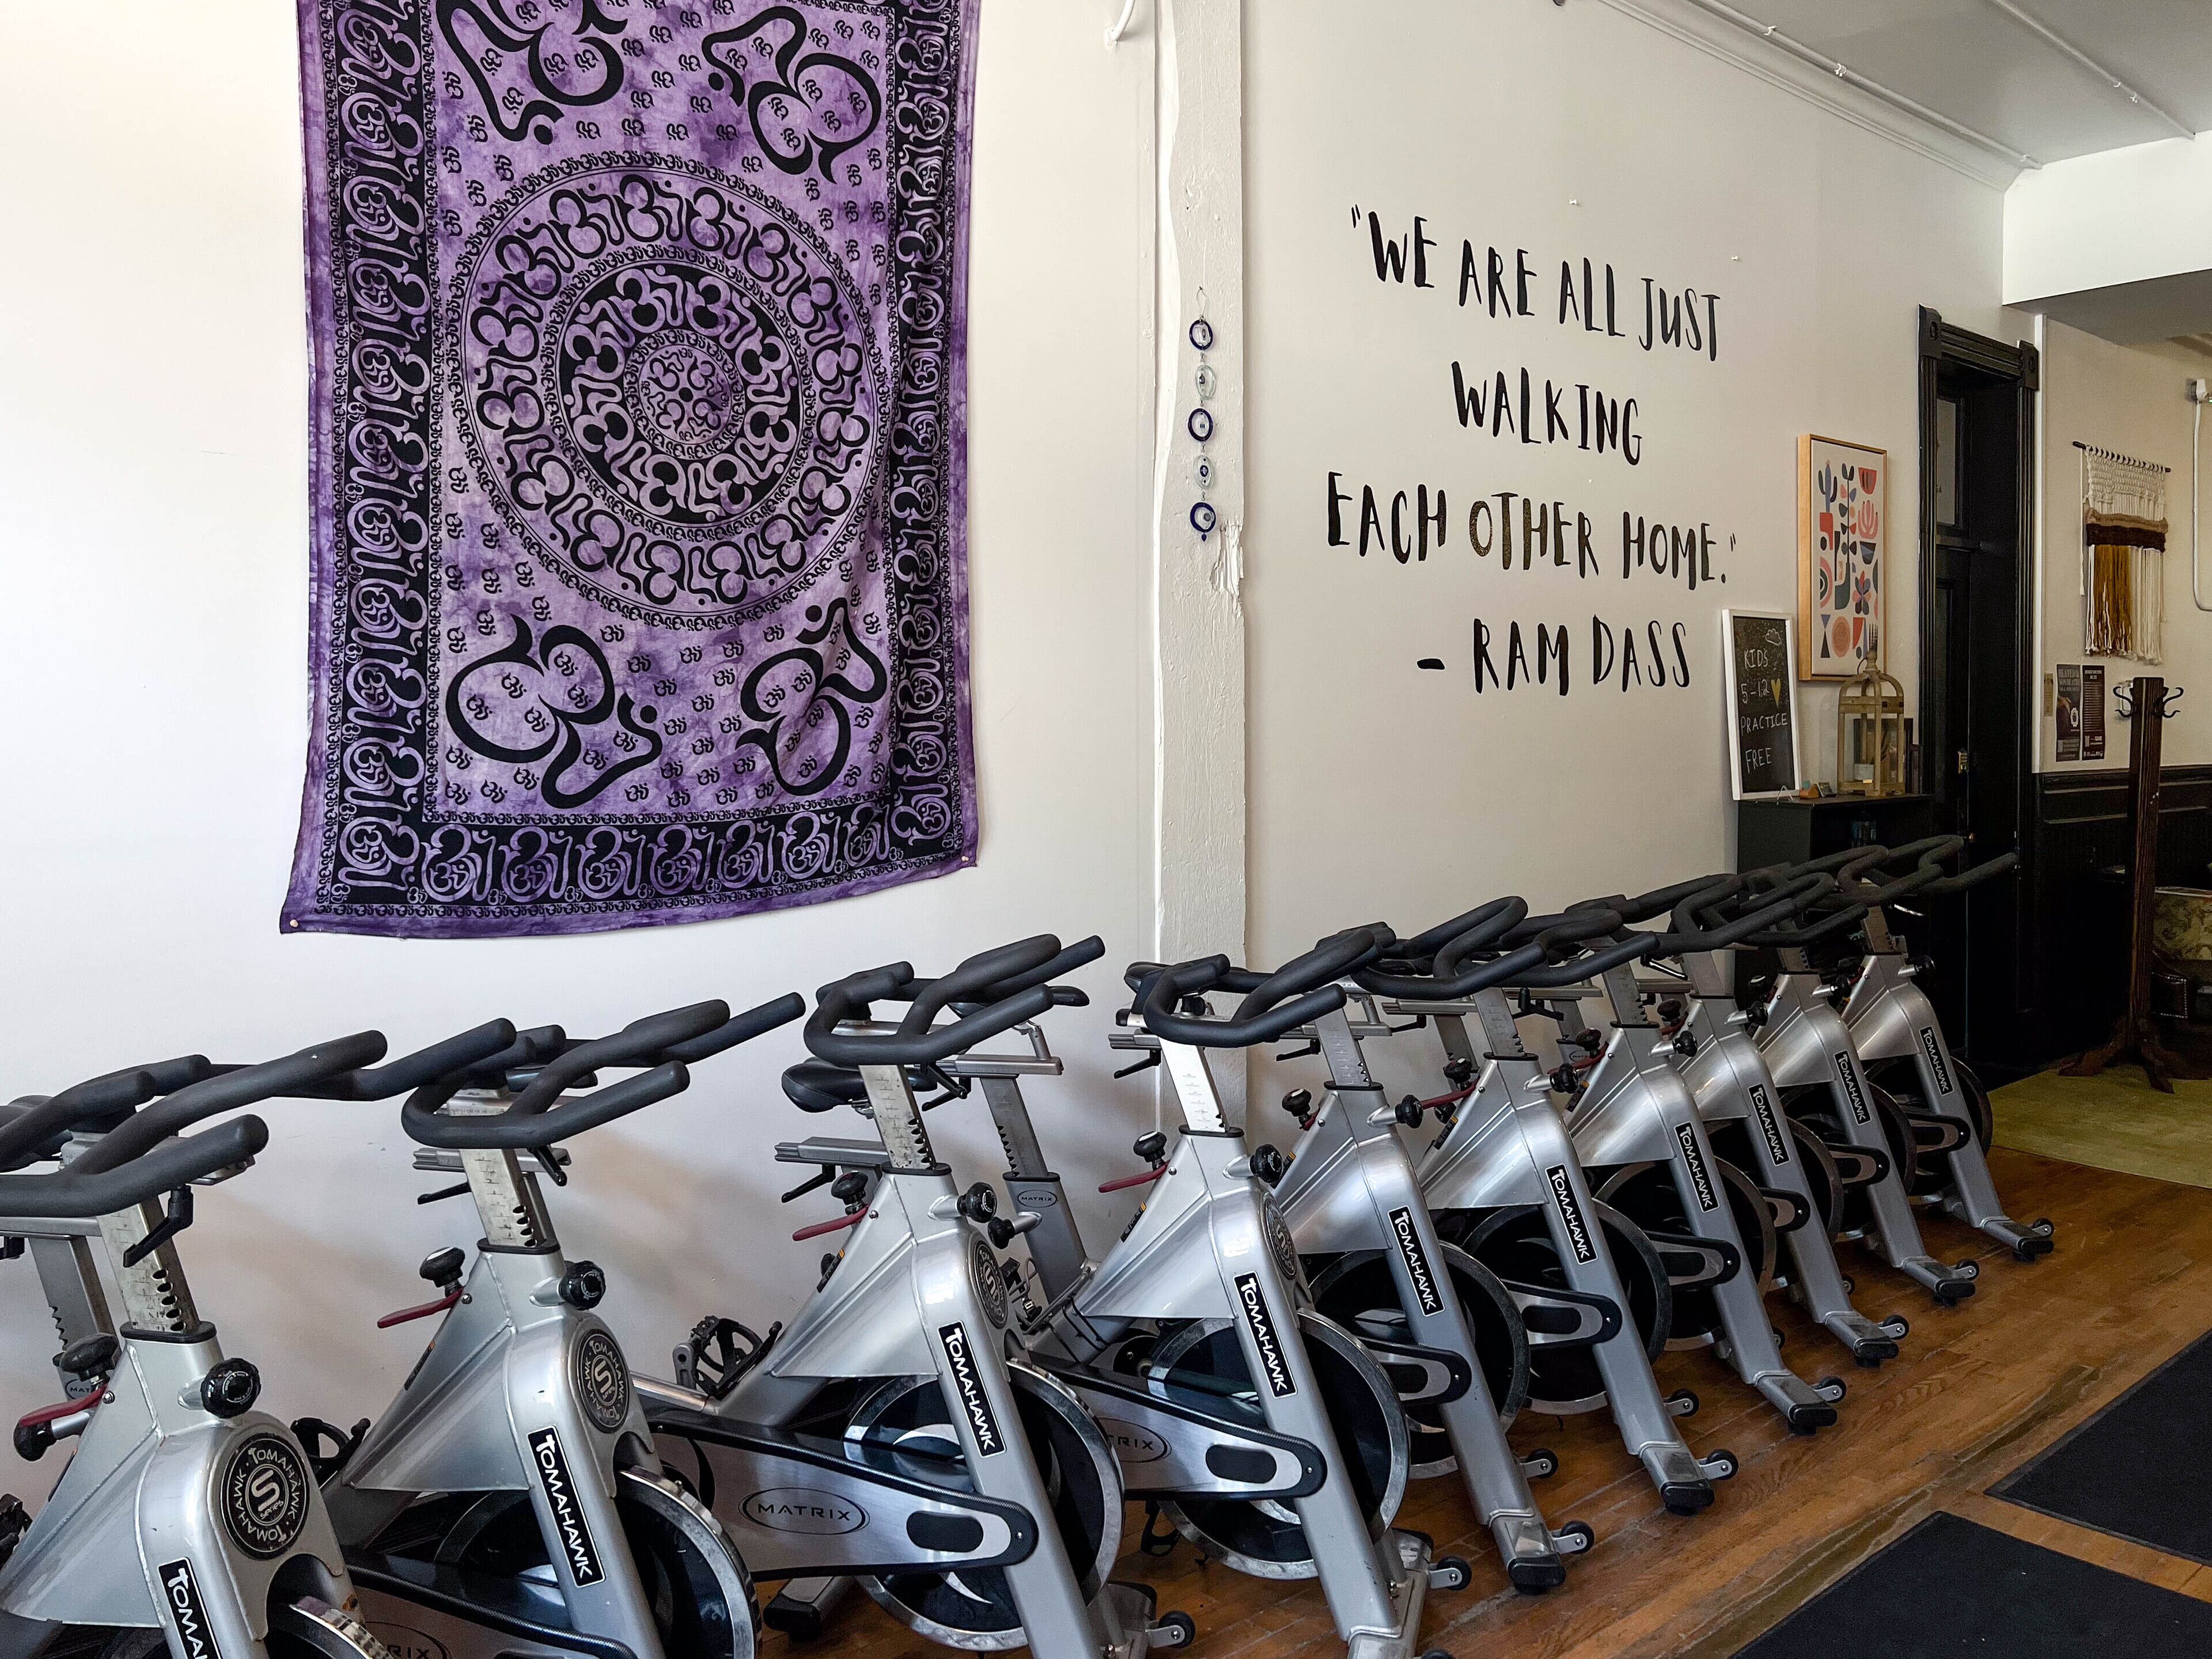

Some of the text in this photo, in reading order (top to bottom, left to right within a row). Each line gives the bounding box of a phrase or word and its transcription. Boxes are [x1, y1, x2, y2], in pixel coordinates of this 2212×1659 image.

[1458, 238, 1537, 319] ARE
[1559, 257, 1626, 337] ALL
[1638, 278, 1721, 362] JUST
[1451, 361, 1643, 466] WALKING
[1328, 471, 1447, 565] EACH
[1468, 492, 1599, 579] OTHER
[1473, 618, 1569, 696] RAM
[1592, 613, 1690, 693] DASS
[1741, 679, 1770, 704] 5-12
[1740, 713, 1788, 736] PRACTICE
[1745, 747, 1772, 774] FREE
[1838, 1054, 1867, 1122] TOMAHAWK
[1923, 1029, 1949, 1092] TOMAHAWK
[1752, 1086, 1785, 1162] TOMAHAWK
[1679, 1126, 1713, 1208] TOMAHAWK
[1553, 1168, 1590, 1259] TOMAHAWK
[1393, 1210, 1436, 1310] TOMAHAWK
[1241, 1277, 1287, 1393] TOMAHAWK
[945, 1327, 995, 1452] TOMAHAWK
[233, 1468, 287, 1543] TOMAHAWK
[248, 1447, 301, 1521] TOMAHAWK
[260, 1499, 284, 1520] series
[535, 1433, 593, 1578] TOMAHAWK
[757, 1503, 851, 1521] MATRIX
[167, 1567, 209, 1659] TOMA
[387, 1644, 430, 1659] RIX
